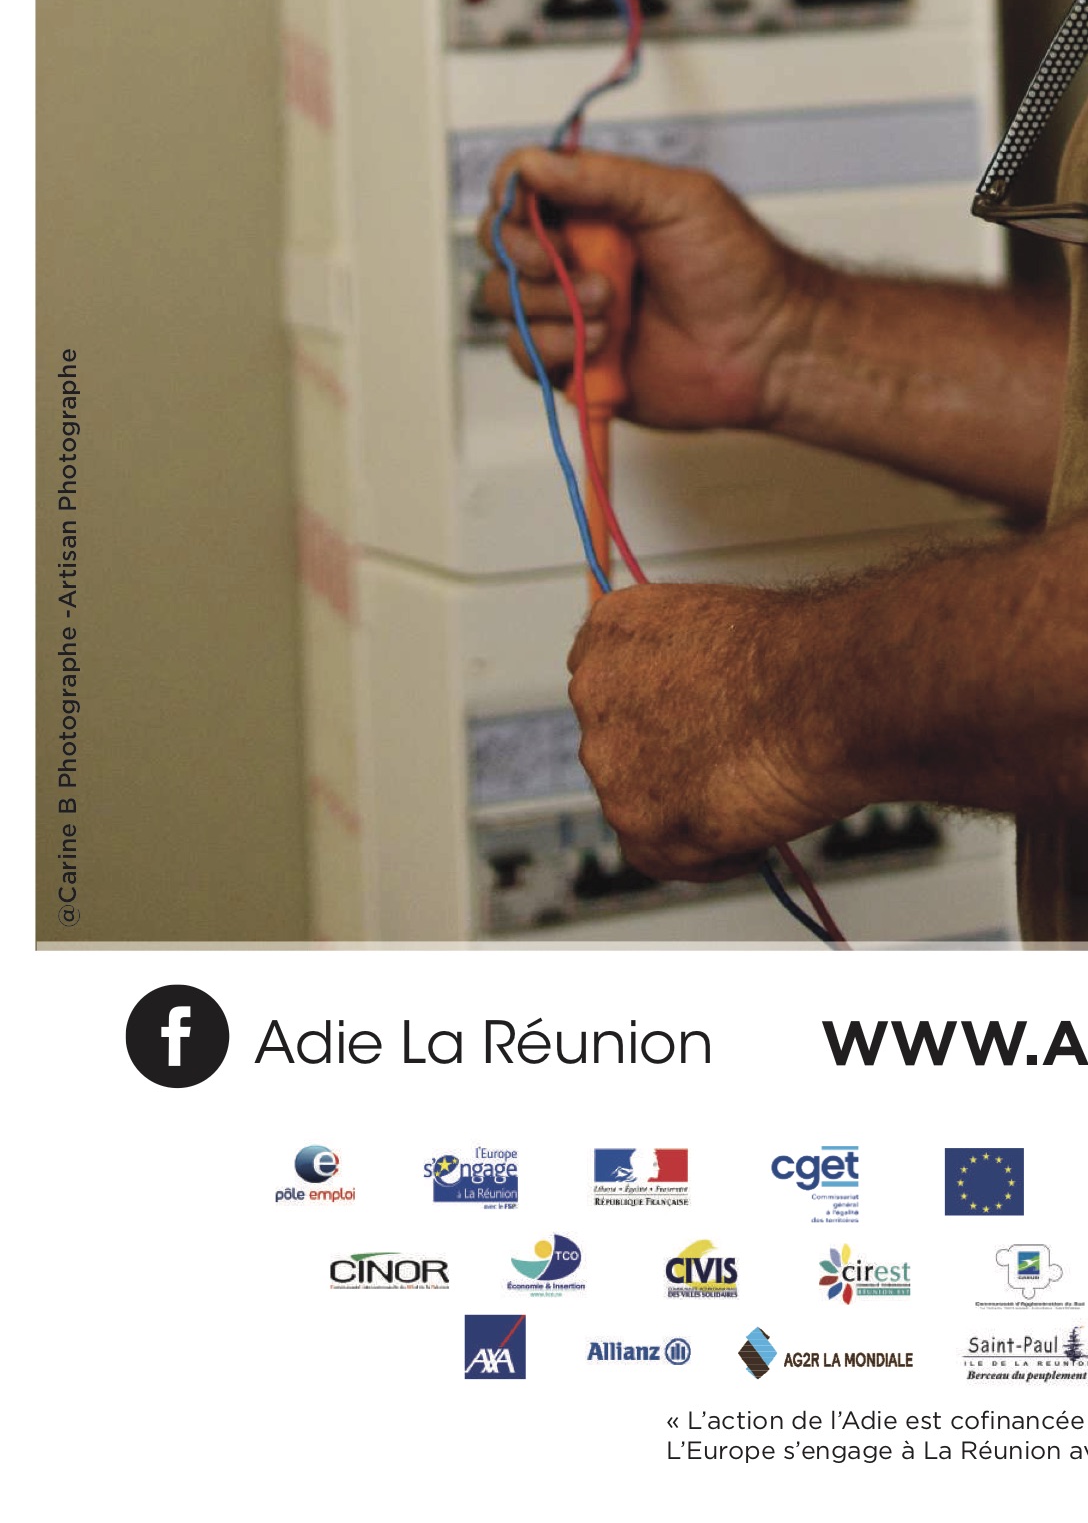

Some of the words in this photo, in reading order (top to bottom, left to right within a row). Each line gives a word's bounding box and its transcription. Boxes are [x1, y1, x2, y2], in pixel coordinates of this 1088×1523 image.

[254, 1019, 383, 1065] Adie
[403, 1019, 463, 1065] La
[486, 1017, 711, 1065] Réunion
[771, 1151, 859, 1191] cget
[275, 1187, 305, 1203] pôle
[309, 1187, 356, 1203] emploi
[464, 1188, 475, 1199] La
[477, 1187, 518, 1199] Réunion
[555, 1250, 579, 1261] TCO
[329, 1259, 450, 1284] CINOR
[665, 1257, 738, 1284] CIVIS
[842, 1259, 911, 1282] cirest
[587, 1342, 660, 1361] Allianz
[968, 1335, 1058, 1354] Saint-Paul
[465, 1347, 515, 1374] AXA
[784, 1352, 820, 1367] AG2R
[823, 1352, 842, 1367] LA
[845, 1352, 914, 1367] MONDIALE
[967, 1370, 1010, 1380] Berceau
[1011, 1370, 1025, 1380] du
[1026, 1370, 1087, 1382] peuplement
[688, 1410, 784, 1430] L’action
[791, 1410, 823, 1430] de
[831, 1410, 898, 1430] l’Adie
[905, 1411, 942, 1430] est
[950, 1409, 1085, 1430] cofinancée
[667, 1440, 776, 1464] L’Europe
[783, 1440, 893, 1464] s’engage
[901, 1439, 915, 1460] à
[924, 1440, 952, 1460] La
[961, 1439, 1061, 1460] Réunion
